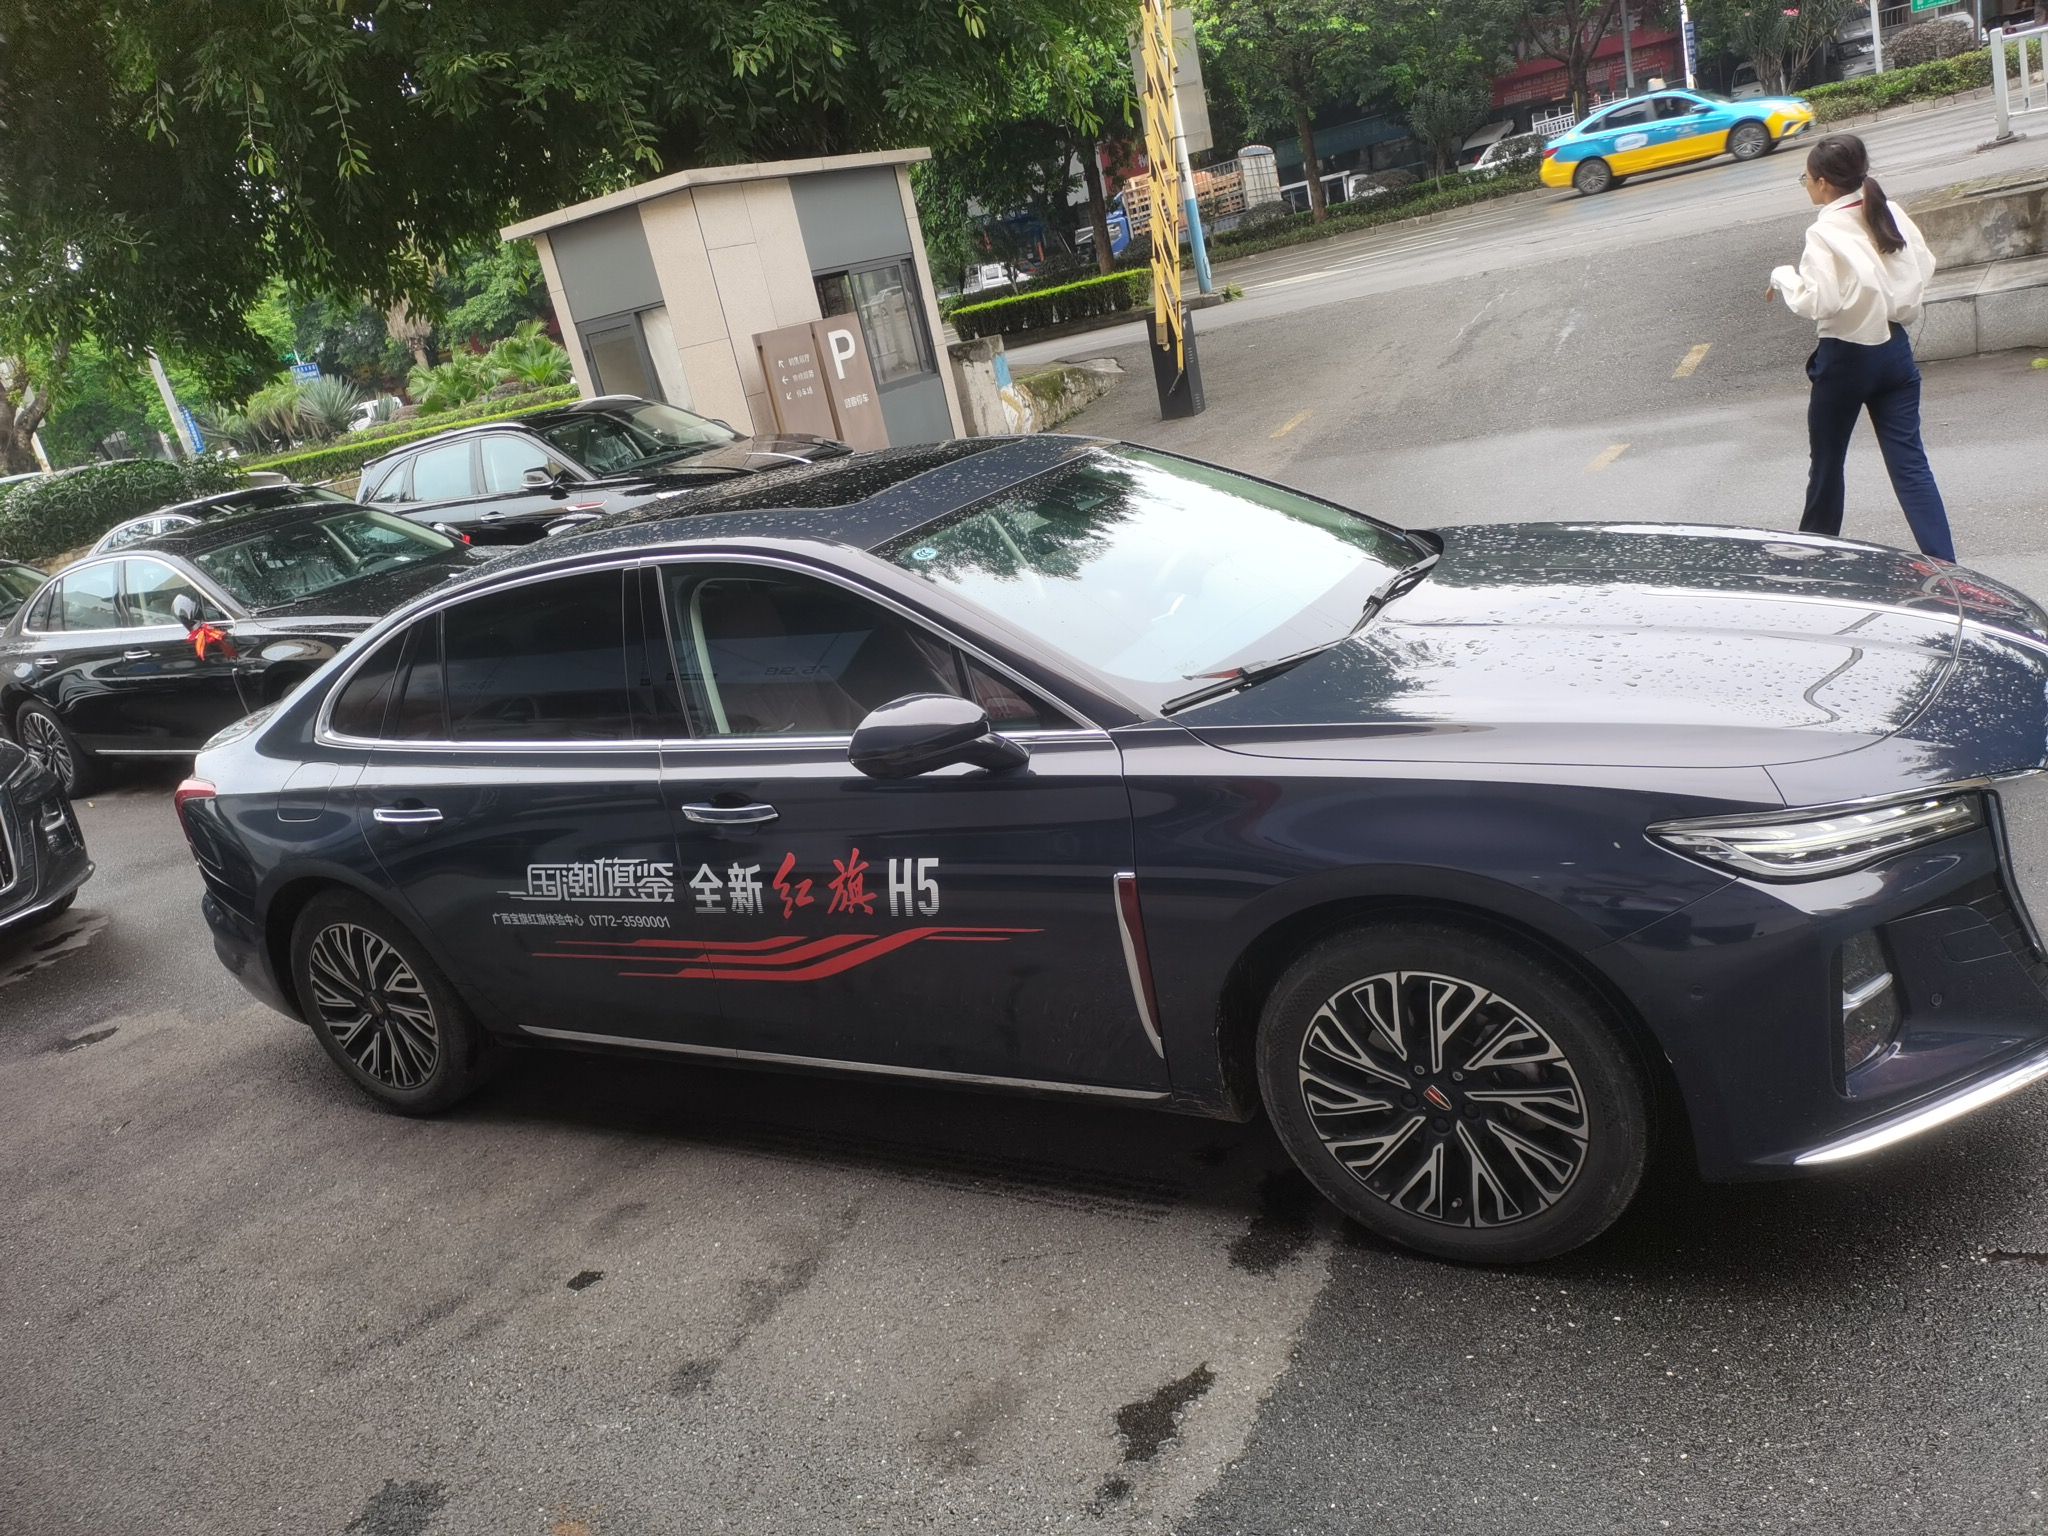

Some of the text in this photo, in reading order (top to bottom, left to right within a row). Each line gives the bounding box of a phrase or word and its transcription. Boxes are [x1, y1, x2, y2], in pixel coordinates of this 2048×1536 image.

[829, 330, 856, 380] P
[689, 862, 764, 915] 全新
[773, 848, 878, 919] 红旗
[888, 858, 940, 917] H5
[588, 914, 671, 928] 0772-3590001
